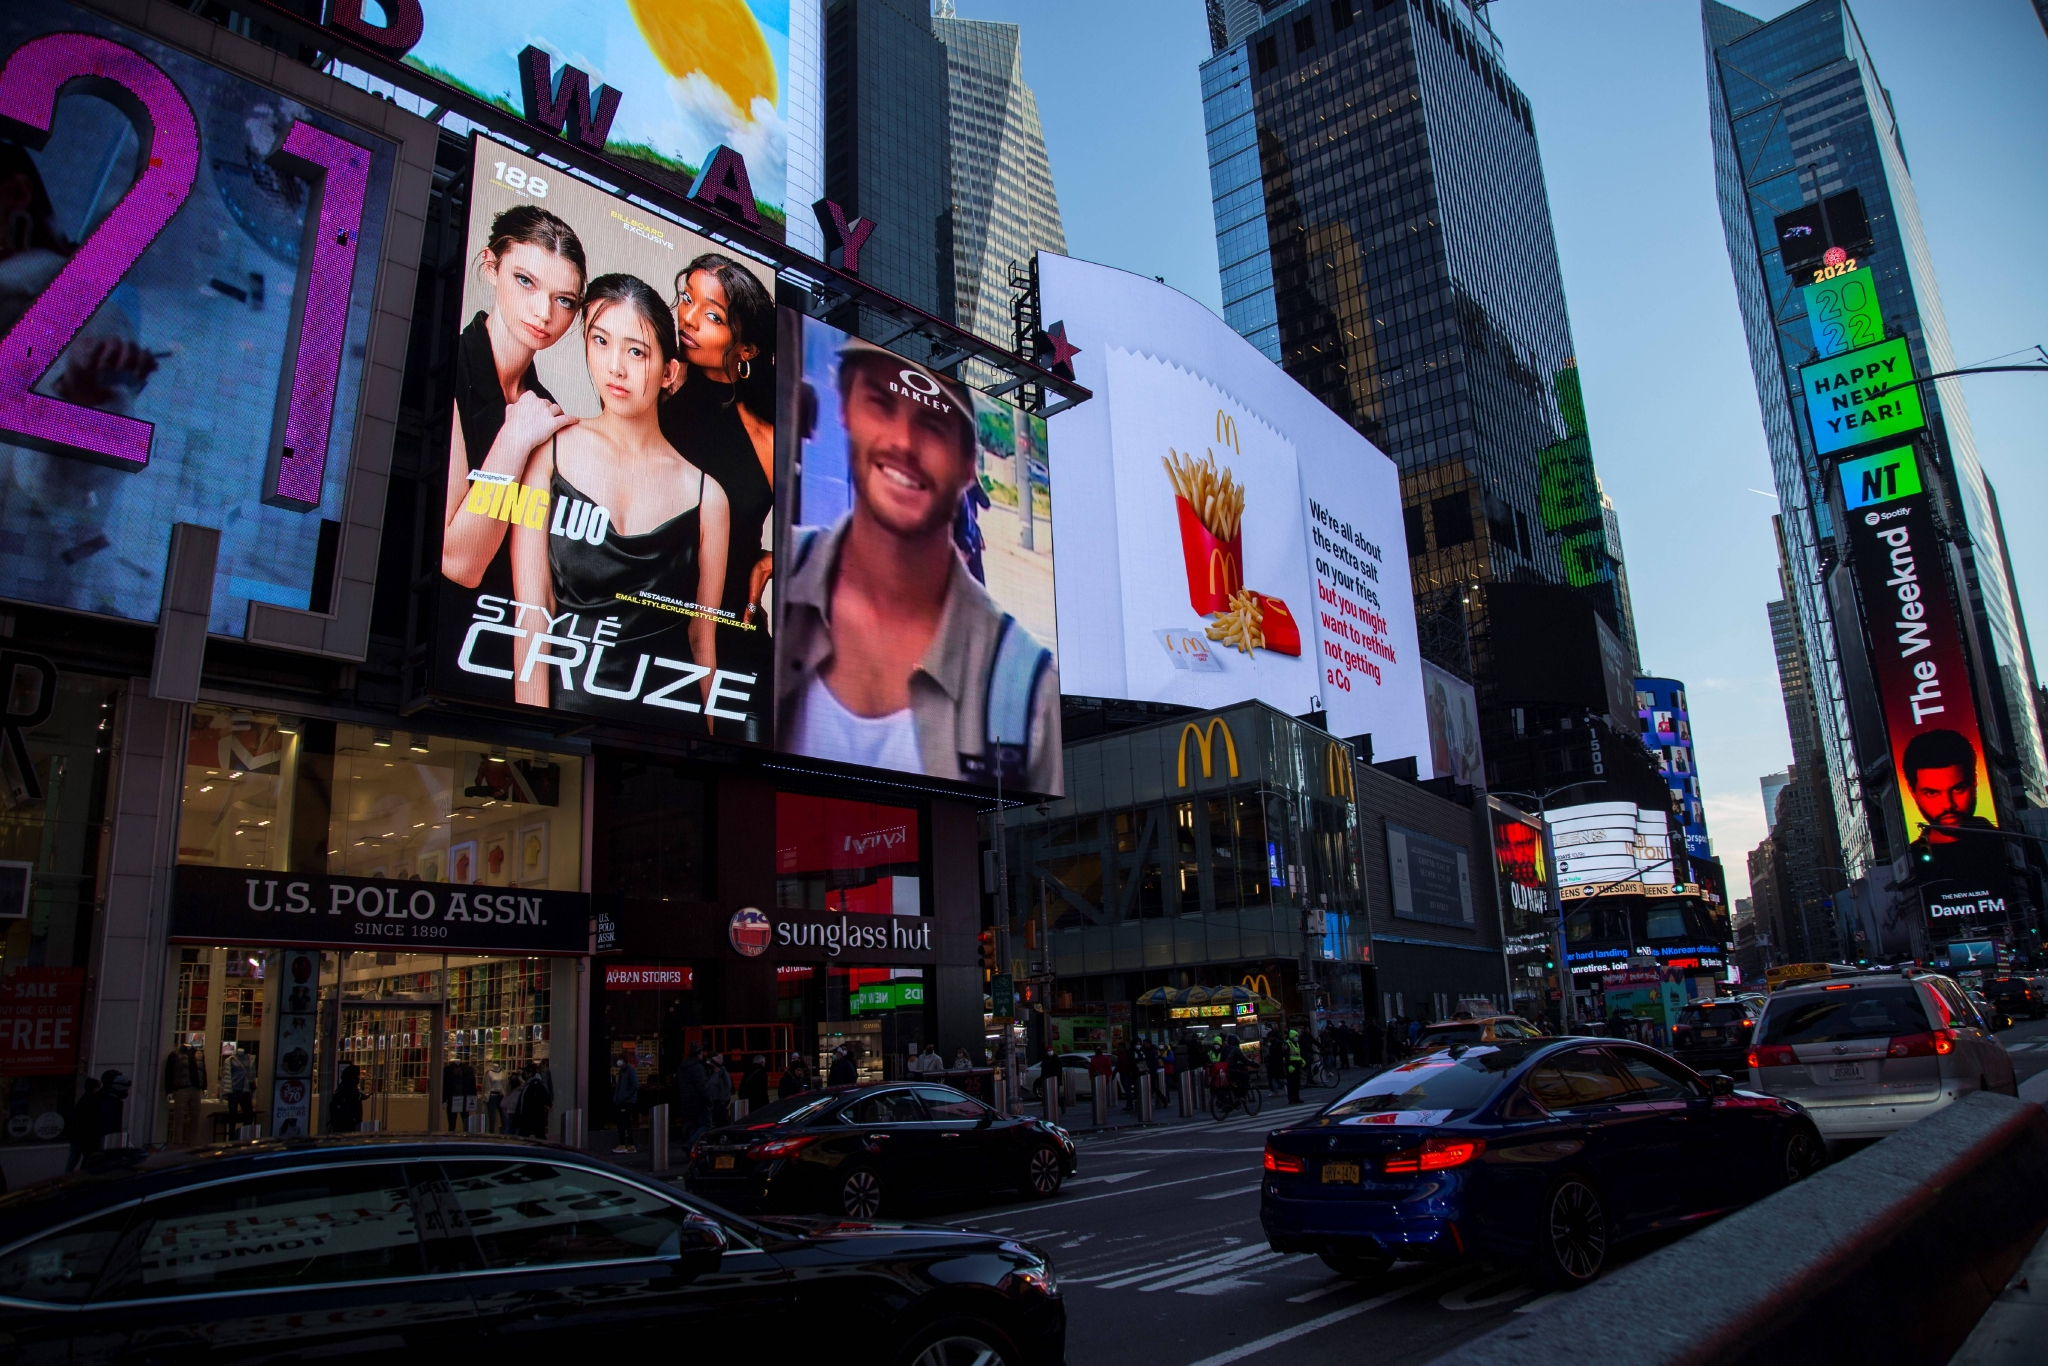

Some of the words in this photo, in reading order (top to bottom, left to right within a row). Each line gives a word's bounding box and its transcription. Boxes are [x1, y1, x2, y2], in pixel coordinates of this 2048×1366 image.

[494, 161, 549, 198] 188
[611, 210, 664, 238] BILLBOARD
[623, 222, 674, 250] EXCLUSIVE
[0, 33, 372, 505] 21
[1813, 258, 1857, 283] 2022
[1816, 280, 1867, 322] 20
[1823, 313, 1875, 355] 22
[1814, 356, 1896, 395] HAPPY
[890, 382, 951, 413] OAKLEY
[1832, 382, 1887, 412] NEW
[1826, 400, 1903, 433] YEAR!
[1861, 462, 1901, 502] NT
[466, 480, 550, 531] BING
[550, 495, 610, 546] LUO
[1881, 507, 1911, 522] Spotify
[1312, 526, 1331, 553] the
[1333, 543, 1359, 571] extra
[1360, 561, 1379, 584] salt
[1341, 522, 1353, 543] all
[1354, 532, 1382, 563] about
[615, 592, 641, 604] EMAIL:
[1316, 557, 1330, 578] on
[1331, 566, 1354, 592] your
[1355, 577, 1381, 610] fries,
[1877, 526, 1931, 658] Weeknd
[639, 590, 683, 606] INSTAGRAM:
[683, 602, 736, 619] @STYLECRUZE
[1318, 578, 1338, 608] but
[1338, 595, 1358, 619] you
[1359, 607, 1388, 636] might
[472, 594, 622, 648] STYLÉ
[1321, 611, 1349, 640] want
[1350, 623, 1361, 645] to
[1362, 633, 1397, 665] rethink
[457, 621, 757, 722] CRUZE
[1324, 640, 1344, 663] not
[1344, 650, 1381, 686] getting
[1327, 668, 1335, 686] a
[1336, 668, 1351, 692] Co
[1909, 660, 1944, 725] The
[1554, 829, 1607, 848] EENS
[246, 879, 316, 914] U.S.
[328, 883, 436, 920] POLO
[443, 892, 548, 926] ASSN.
[1510, 881, 1528, 910] OLD
[1597, 884, 1638, 894] TUESDAYS
[1930, 903, 1976, 918] Dawn
[1978, 898, 2005, 913] FM
[354, 922, 405, 937] SINCE
[411, 925, 448, 939] 1890
[597, 931, 616, 943] ASSN.
[598, 922, 615, 933] POLO
[777, 915, 888, 956] sunglass
[892, 918, 931, 950] hut
[1576, 951, 1594, 960] hard
[1595, 948, 1628, 958] landing
[1661, 946, 1696, 956] NKorean
[14, 982, 58, 998] SALE
[642, 971, 681, 984] STORIES
[37, 1005, 54, 1015] GET
[57, 1005, 73, 1015] ONE
